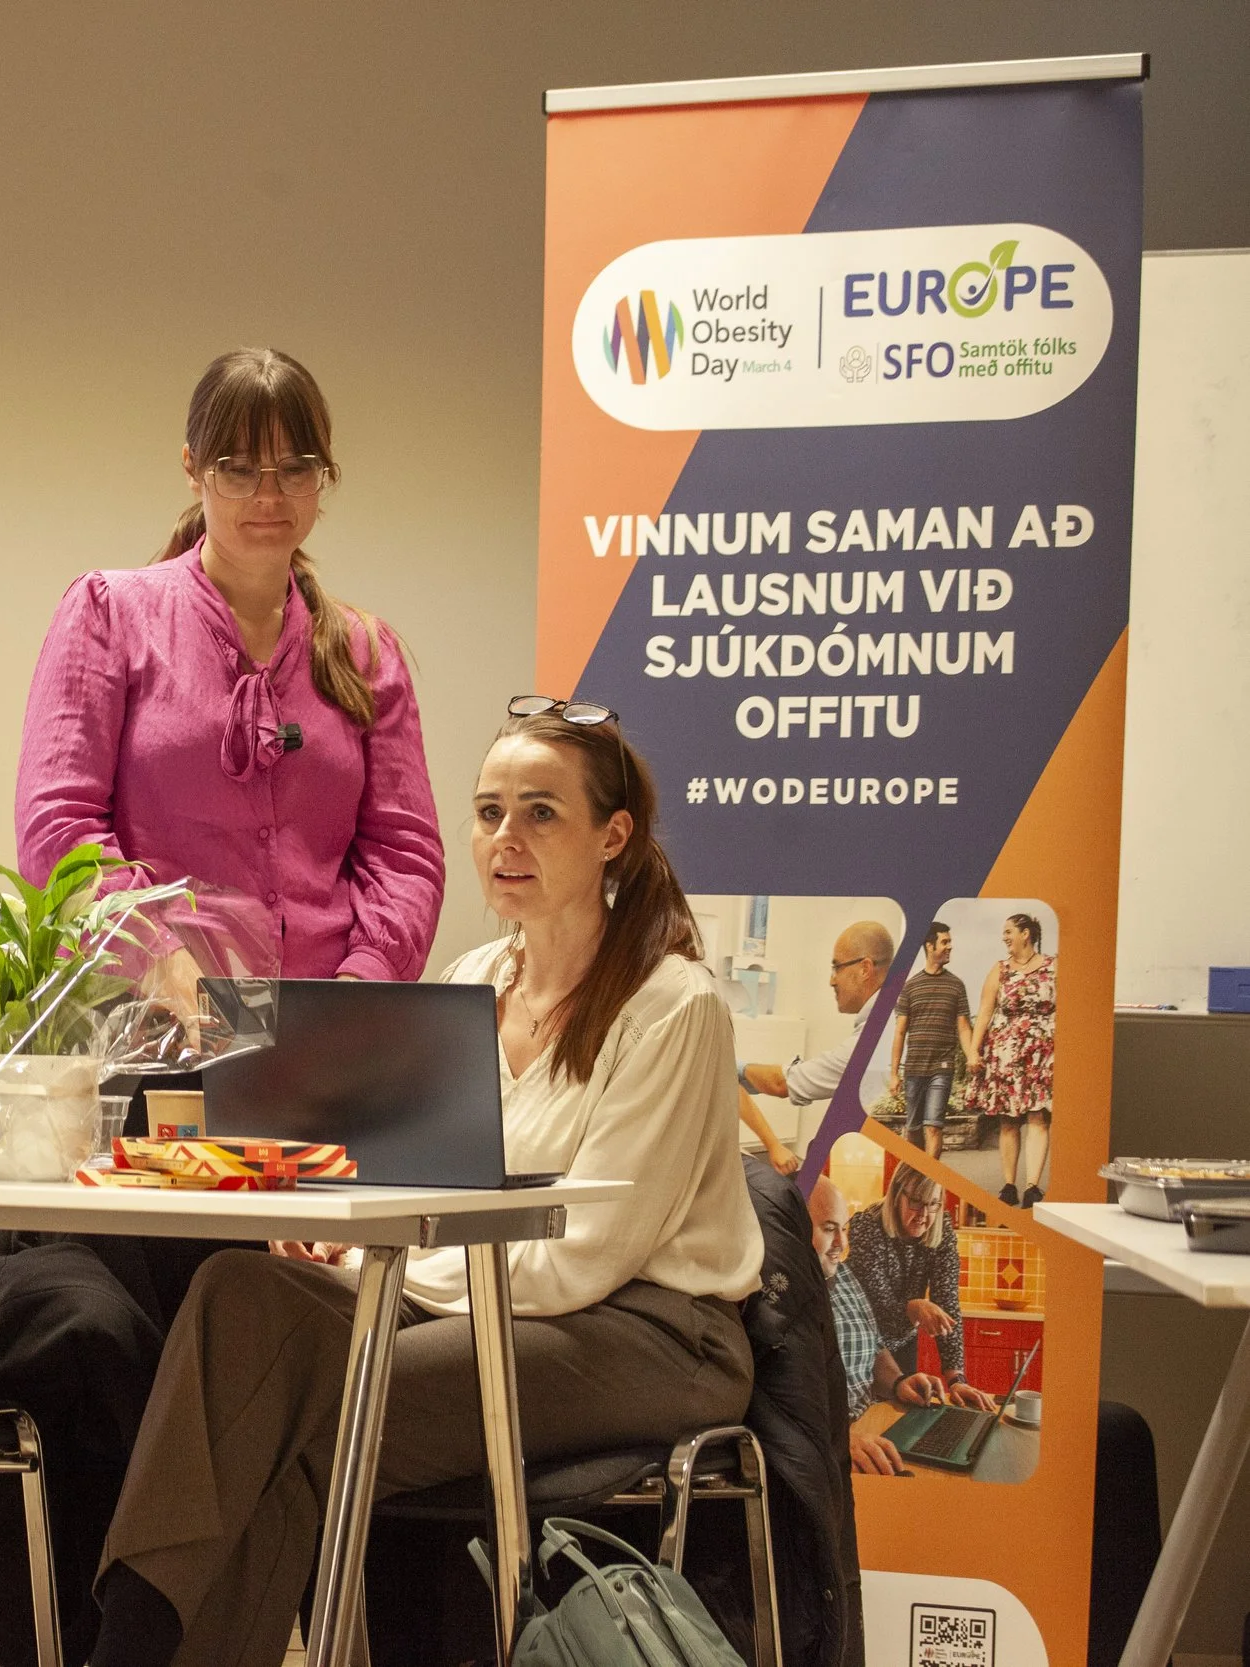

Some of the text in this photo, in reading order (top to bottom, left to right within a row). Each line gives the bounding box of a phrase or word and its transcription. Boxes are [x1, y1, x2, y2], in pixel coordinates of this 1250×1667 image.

[692, 284, 768, 312] World
[844, 240, 1076, 318] EUROPE
[692, 318, 793, 348] Obesity
[691, 352, 792, 382] Day March 4
[883, 337, 1077, 380] SFO Samtök fólks
[958, 358, 1053, 378] með offitu
[584, 504, 1095, 557] VINNUM SAMAN AÐ
[651, 568, 1014, 617] LAUSNUM VIÐ
[643, 622, 1015, 678] SJÚKDÓMNUM
[735, 694, 921, 739] OFFITU
[686, 777, 959, 805] #WODEUROPE
